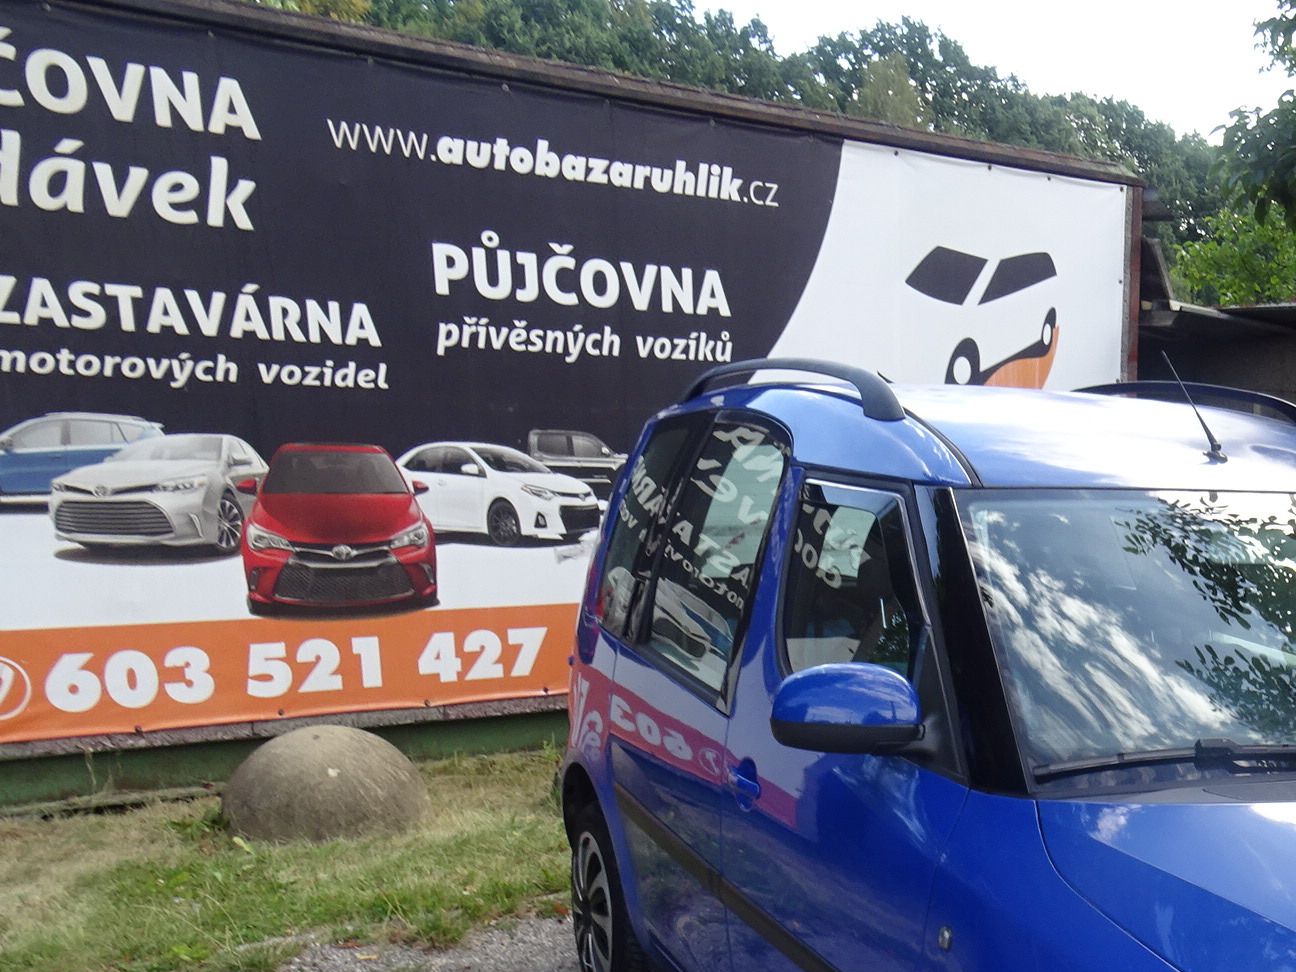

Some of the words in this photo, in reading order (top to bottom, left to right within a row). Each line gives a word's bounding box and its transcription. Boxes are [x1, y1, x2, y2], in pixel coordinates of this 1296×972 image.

[327, 118, 779, 207] www.autobazaruhlik.cz
[432, 230, 732, 317] PŮJČOVNA
[258, 360, 389, 389] vozidel
[436, 316, 620, 364] přívěsných
[636, 331, 733, 362] vozíků
[44, 646, 215, 713] 603
[247, 636, 383, 698] 521
[418, 627, 548, 683] 427
